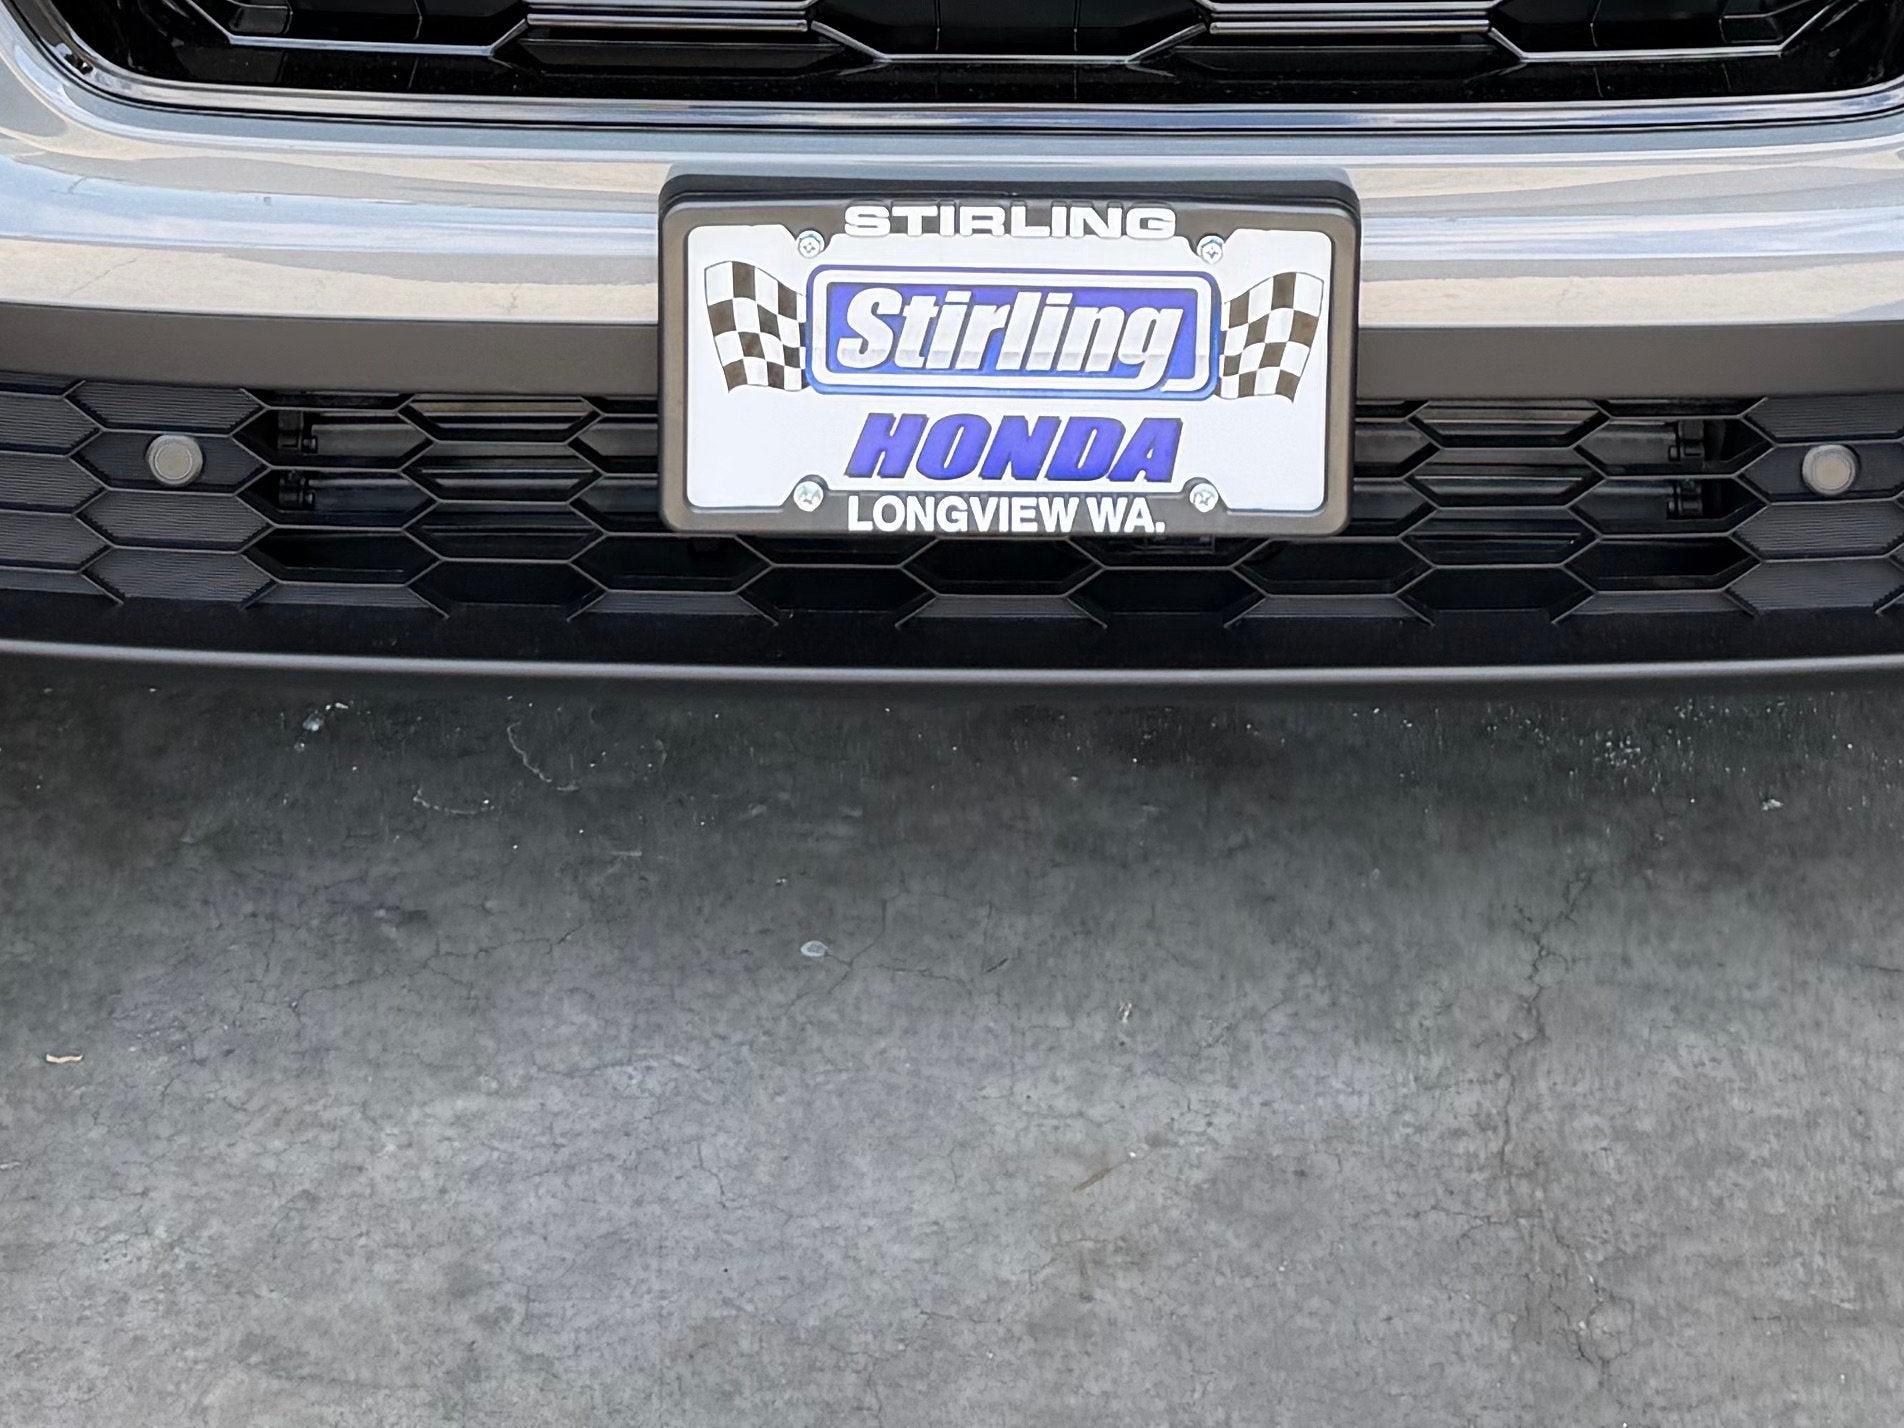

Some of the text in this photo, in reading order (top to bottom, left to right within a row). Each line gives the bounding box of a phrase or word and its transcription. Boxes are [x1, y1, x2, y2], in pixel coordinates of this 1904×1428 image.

[844, 205, 1176, 239] STIRLING
[837, 287, 1185, 391] Stirling
[844, 412, 1183, 482] HONDA
[847, 495, 1165, 534] LONGVIEW WA.
